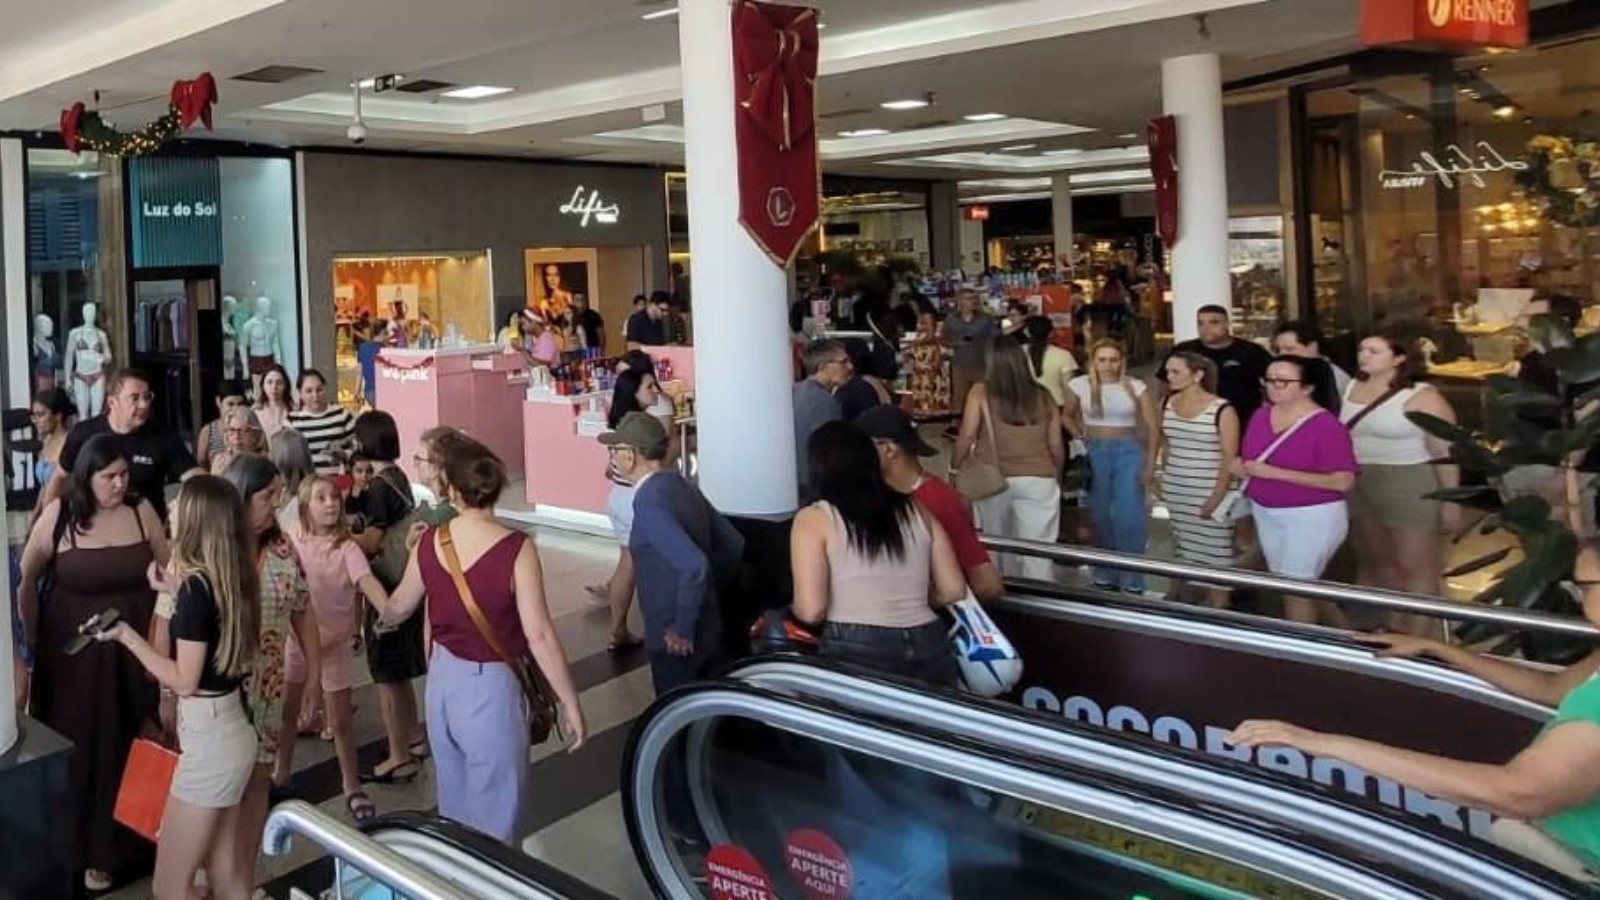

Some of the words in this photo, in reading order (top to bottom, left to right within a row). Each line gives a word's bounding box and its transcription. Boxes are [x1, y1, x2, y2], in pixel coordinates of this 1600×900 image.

[1452, 0, 1516, 26] RENNER
[143, 202, 170, 217] Luz
[173, 201, 192, 217] do
[194, 201, 217, 217] Sol
[791, 857, 849, 887] APERTE
[712, 875, 767, 900] APERTE
[804, 877, 836, 895] AQUI
